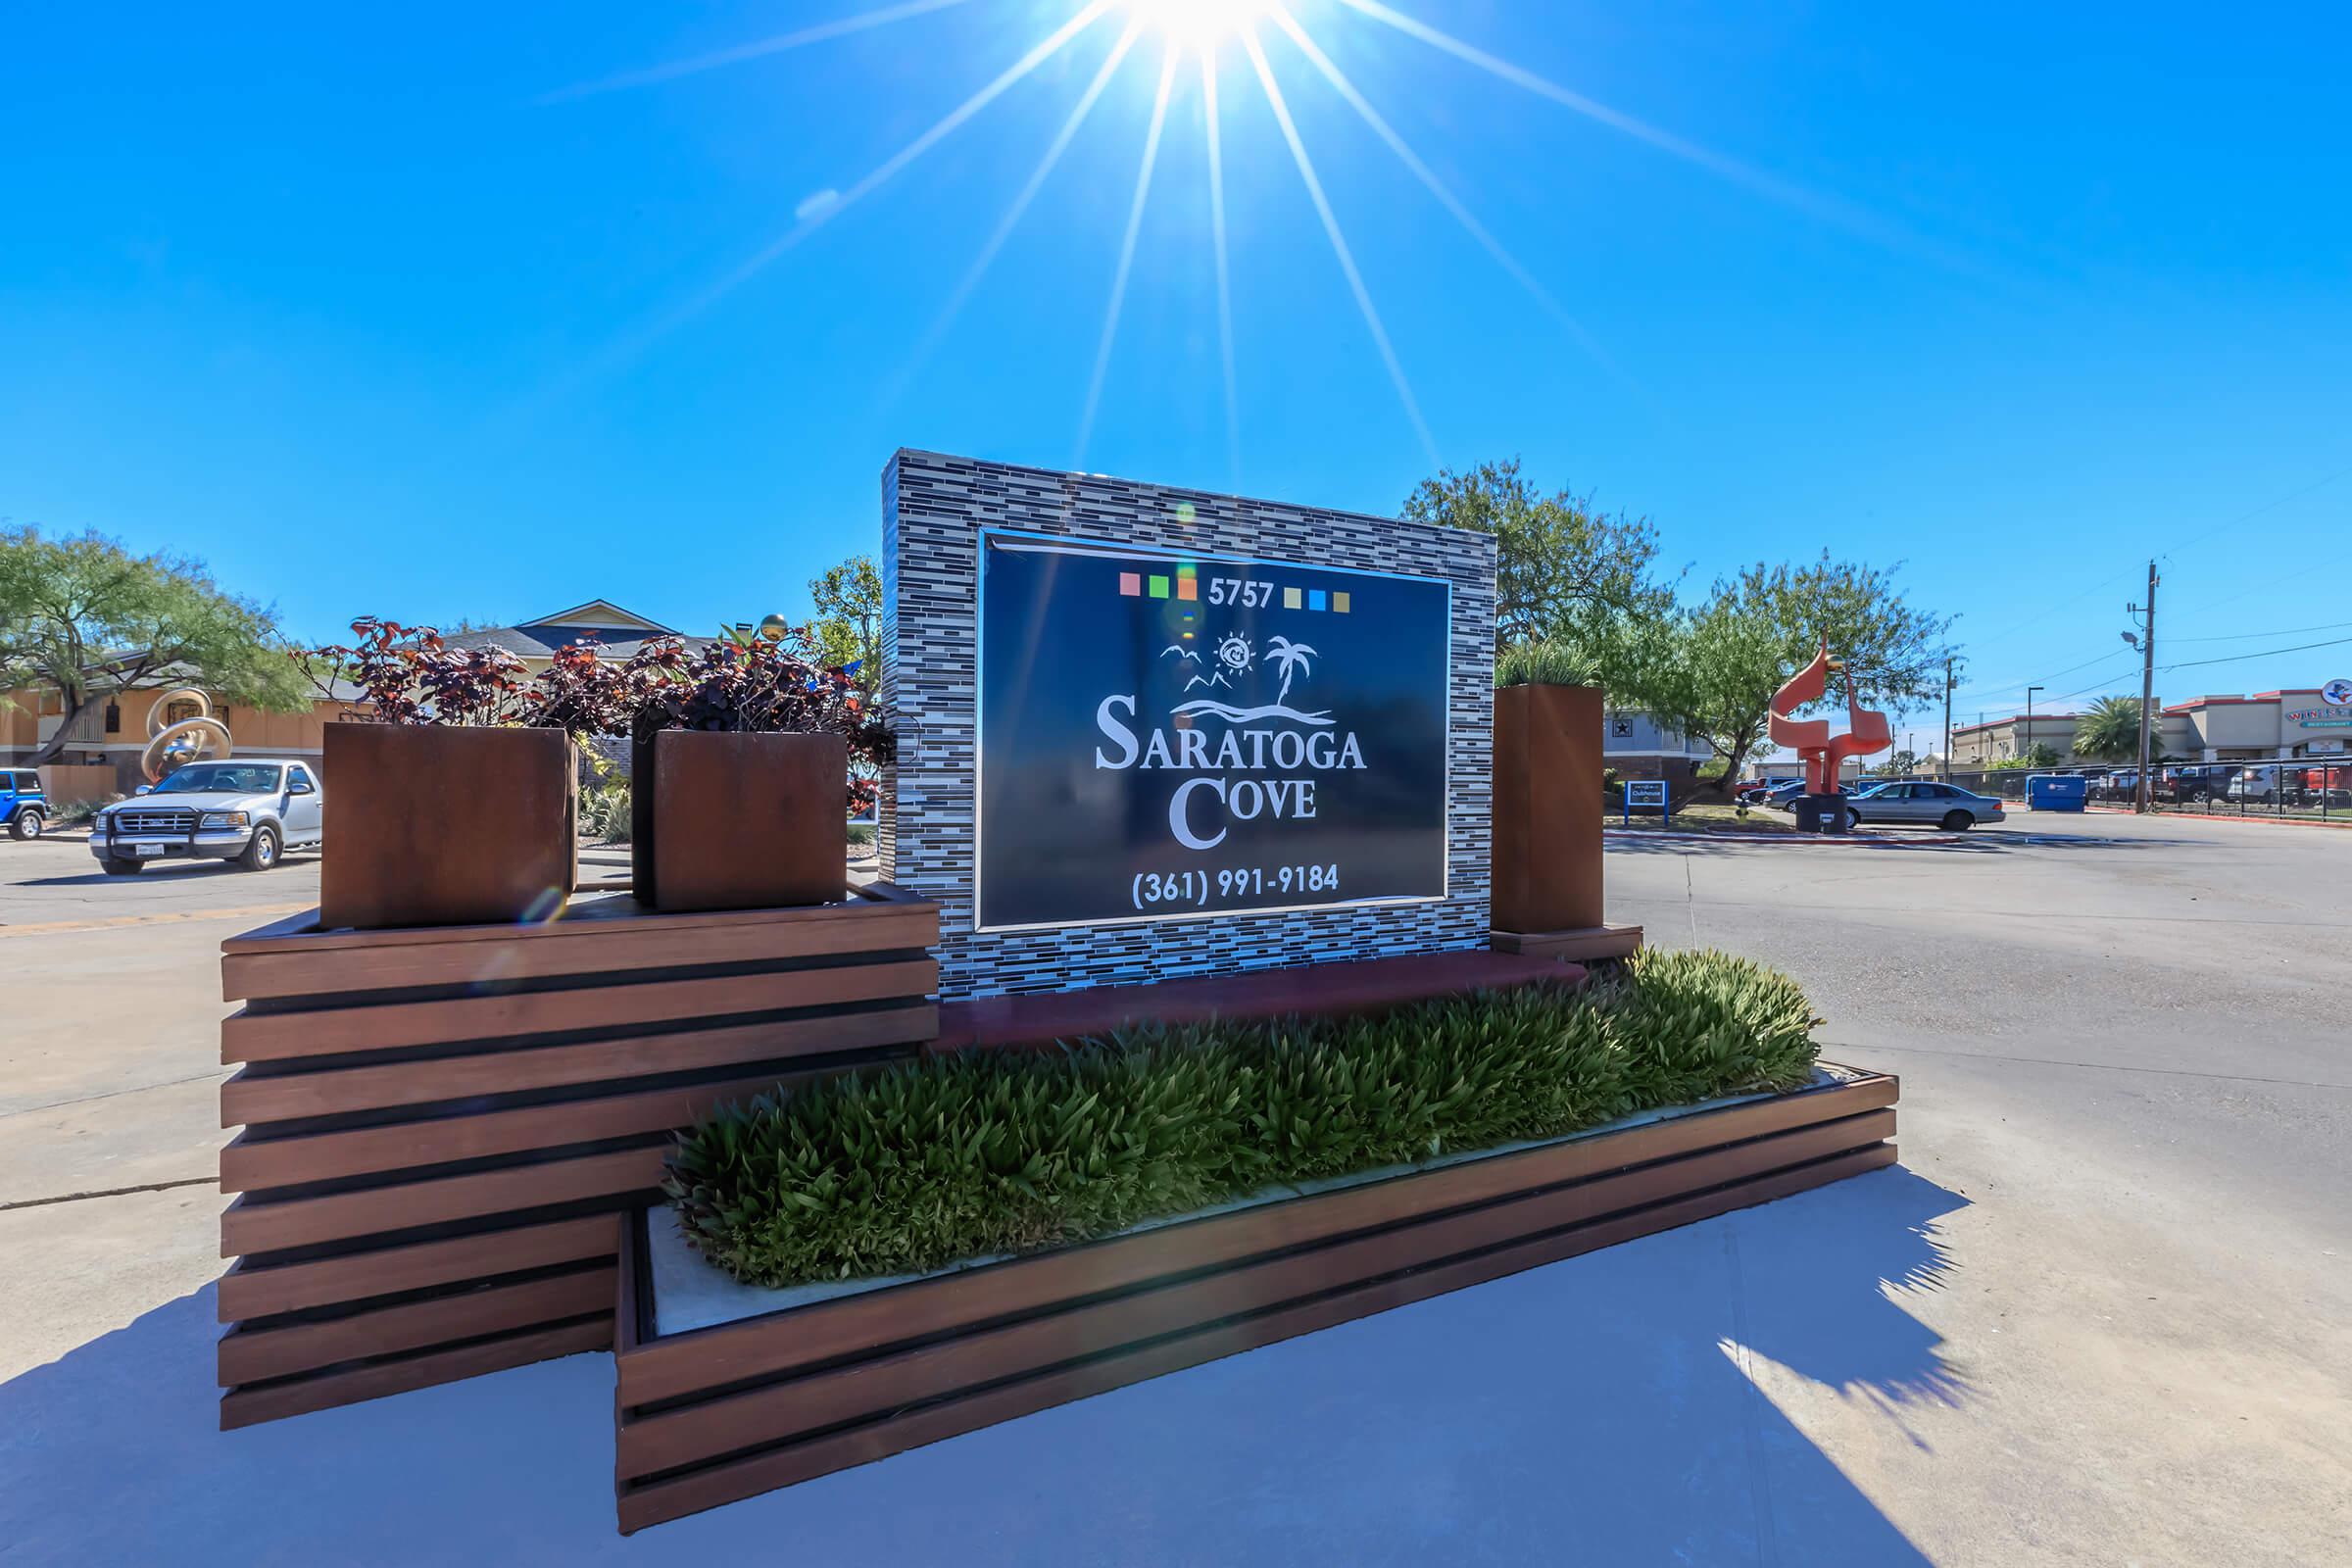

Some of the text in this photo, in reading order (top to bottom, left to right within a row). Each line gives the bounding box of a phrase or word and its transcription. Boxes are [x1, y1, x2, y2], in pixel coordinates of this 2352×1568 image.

[1208, 577, 1275, 609] 5757
[1096, 695, 1368, 770] SARATOGA
[1169, 777, 1317, 851] COVE
[1133, 864, 1340, 909] (361) 991-9184
